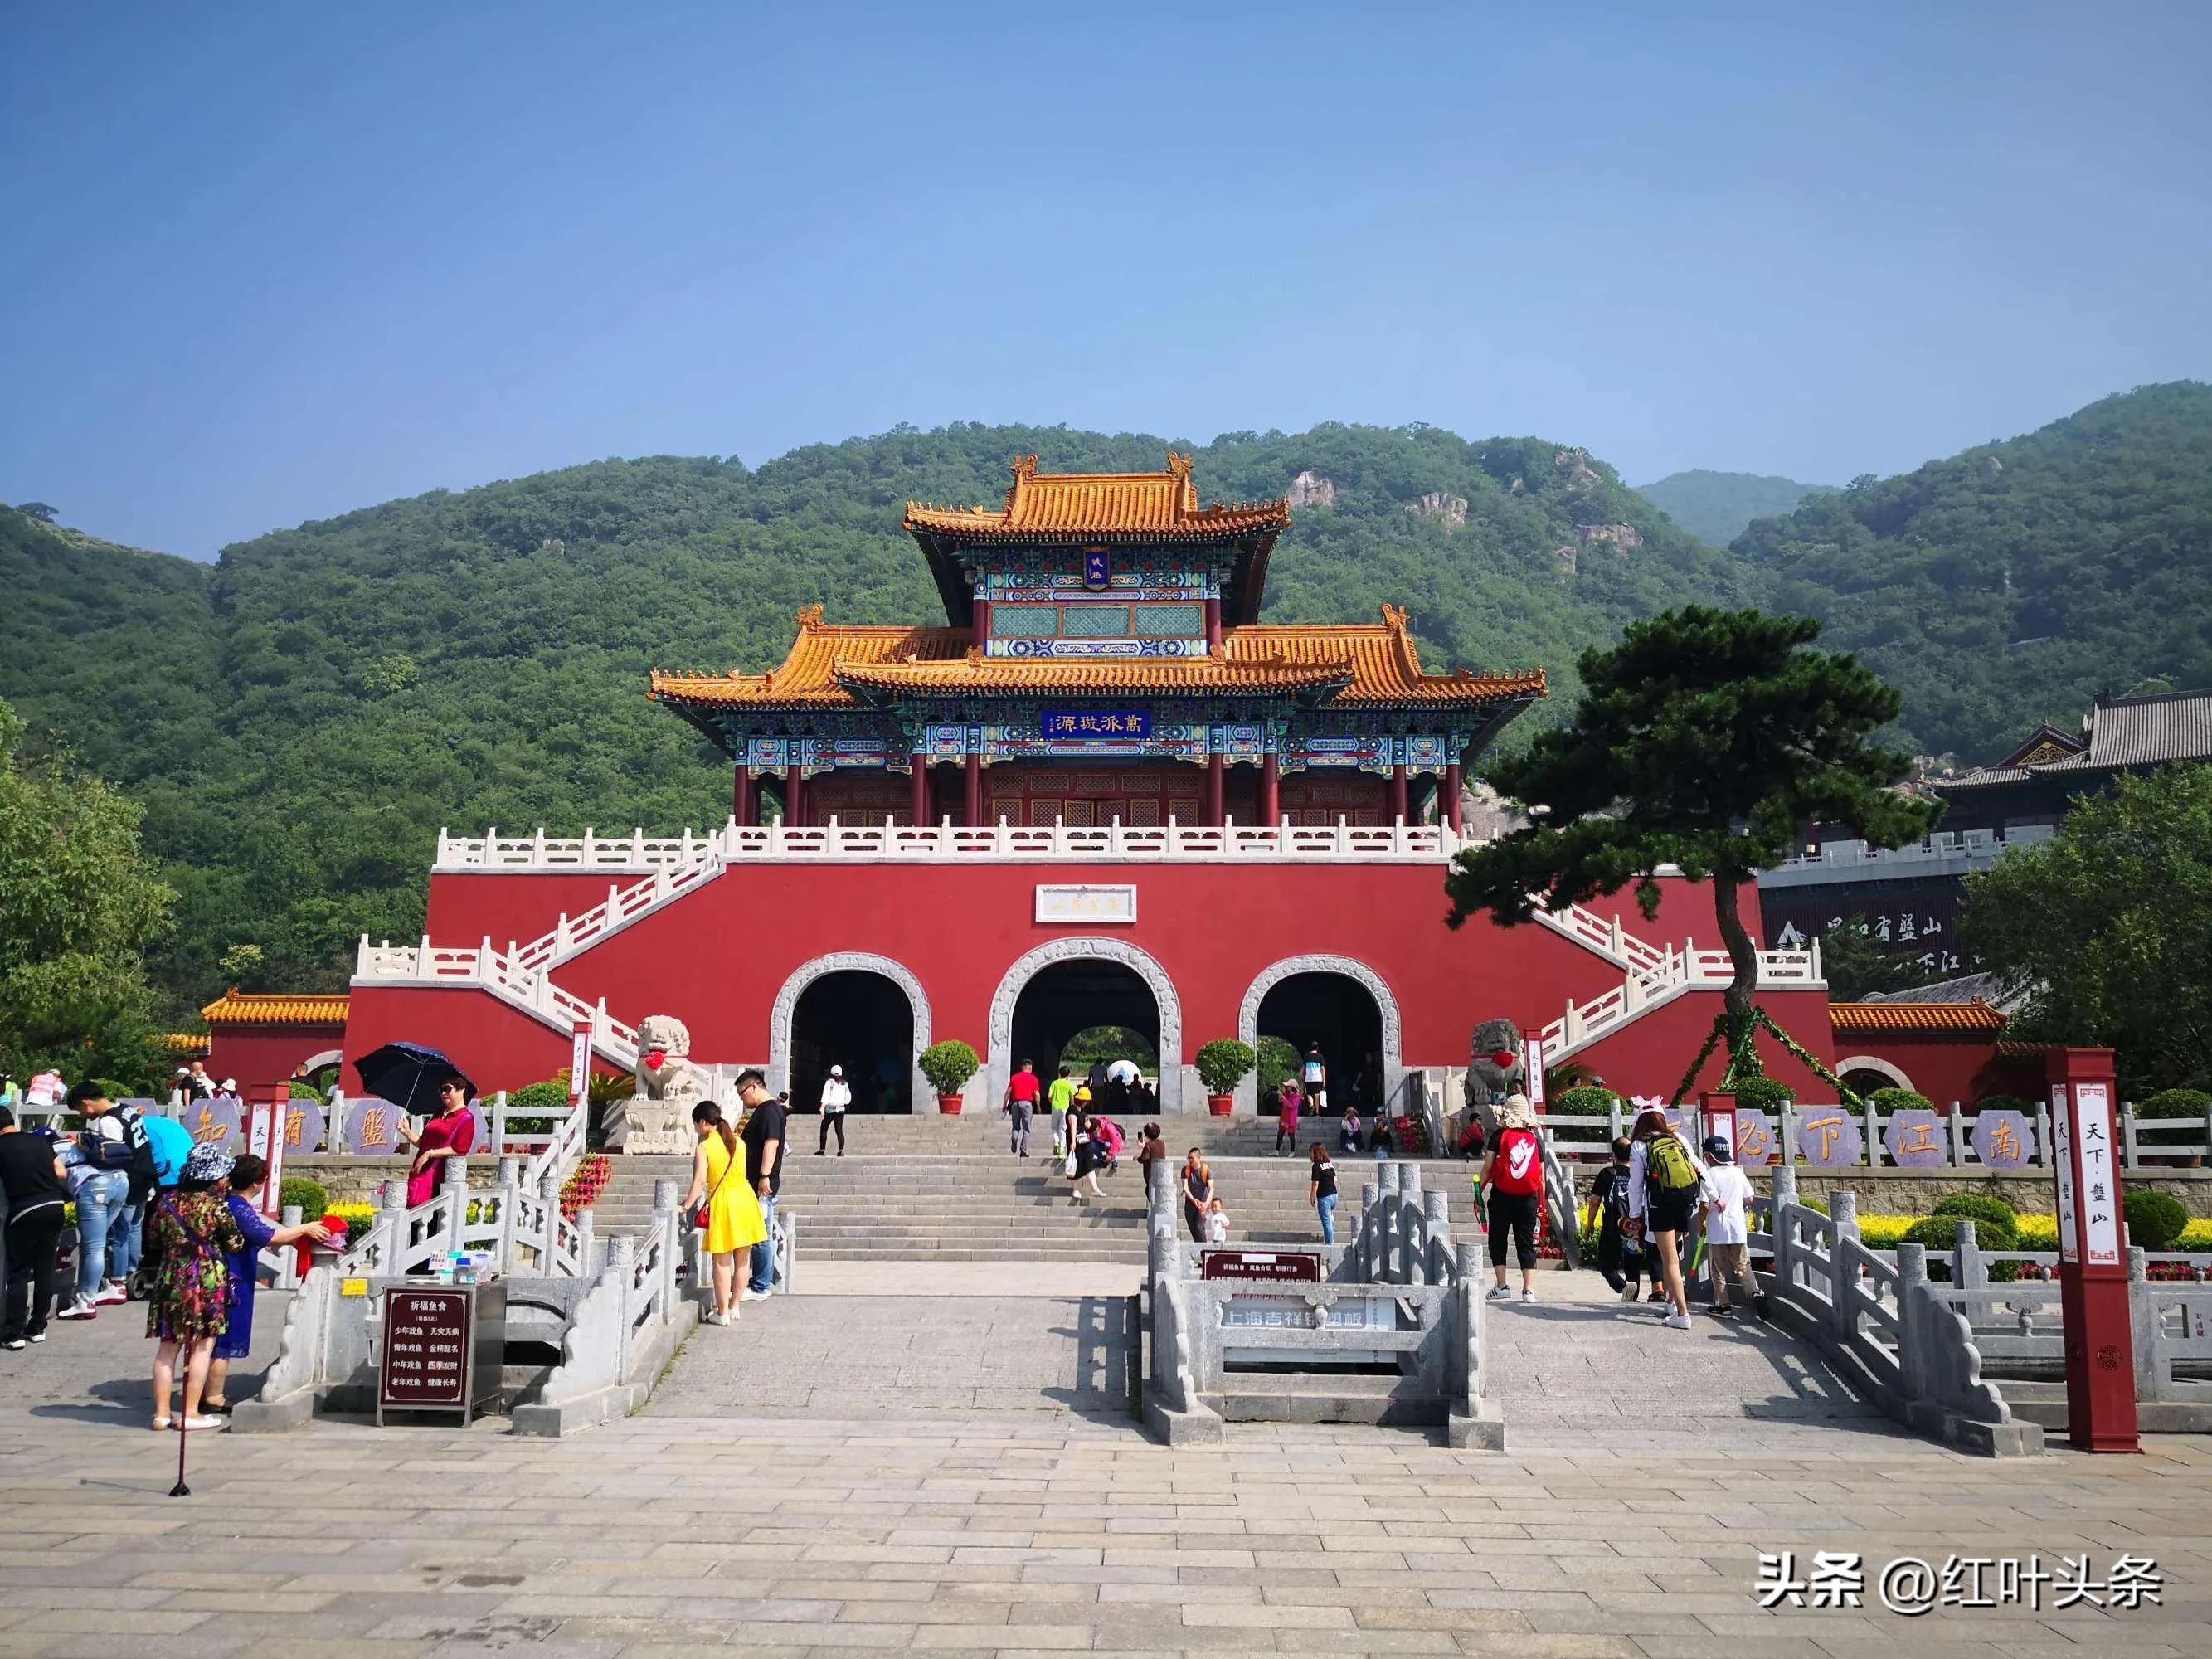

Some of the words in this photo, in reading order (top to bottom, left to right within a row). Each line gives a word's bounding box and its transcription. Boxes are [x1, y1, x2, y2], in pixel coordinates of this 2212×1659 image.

[410, 1300, 447, 1311] 祈福鱼食
[394, 1326, 424, 1335] 少年戏鱼
[430, 1327, 459, 1336] 无灾无病
[394, 1343, 423, 1353] 青年戏鱼
[429, 1344, 458, 1353] 金榜题名
[392, 1360, 422, 1370] 中年戏鱼
[427, 1360, 458, 1370] 四季发财
[391, 1378, 421, 1387] 老年戏鱼
[427, 1378, 457, 1388] 健康长寿
